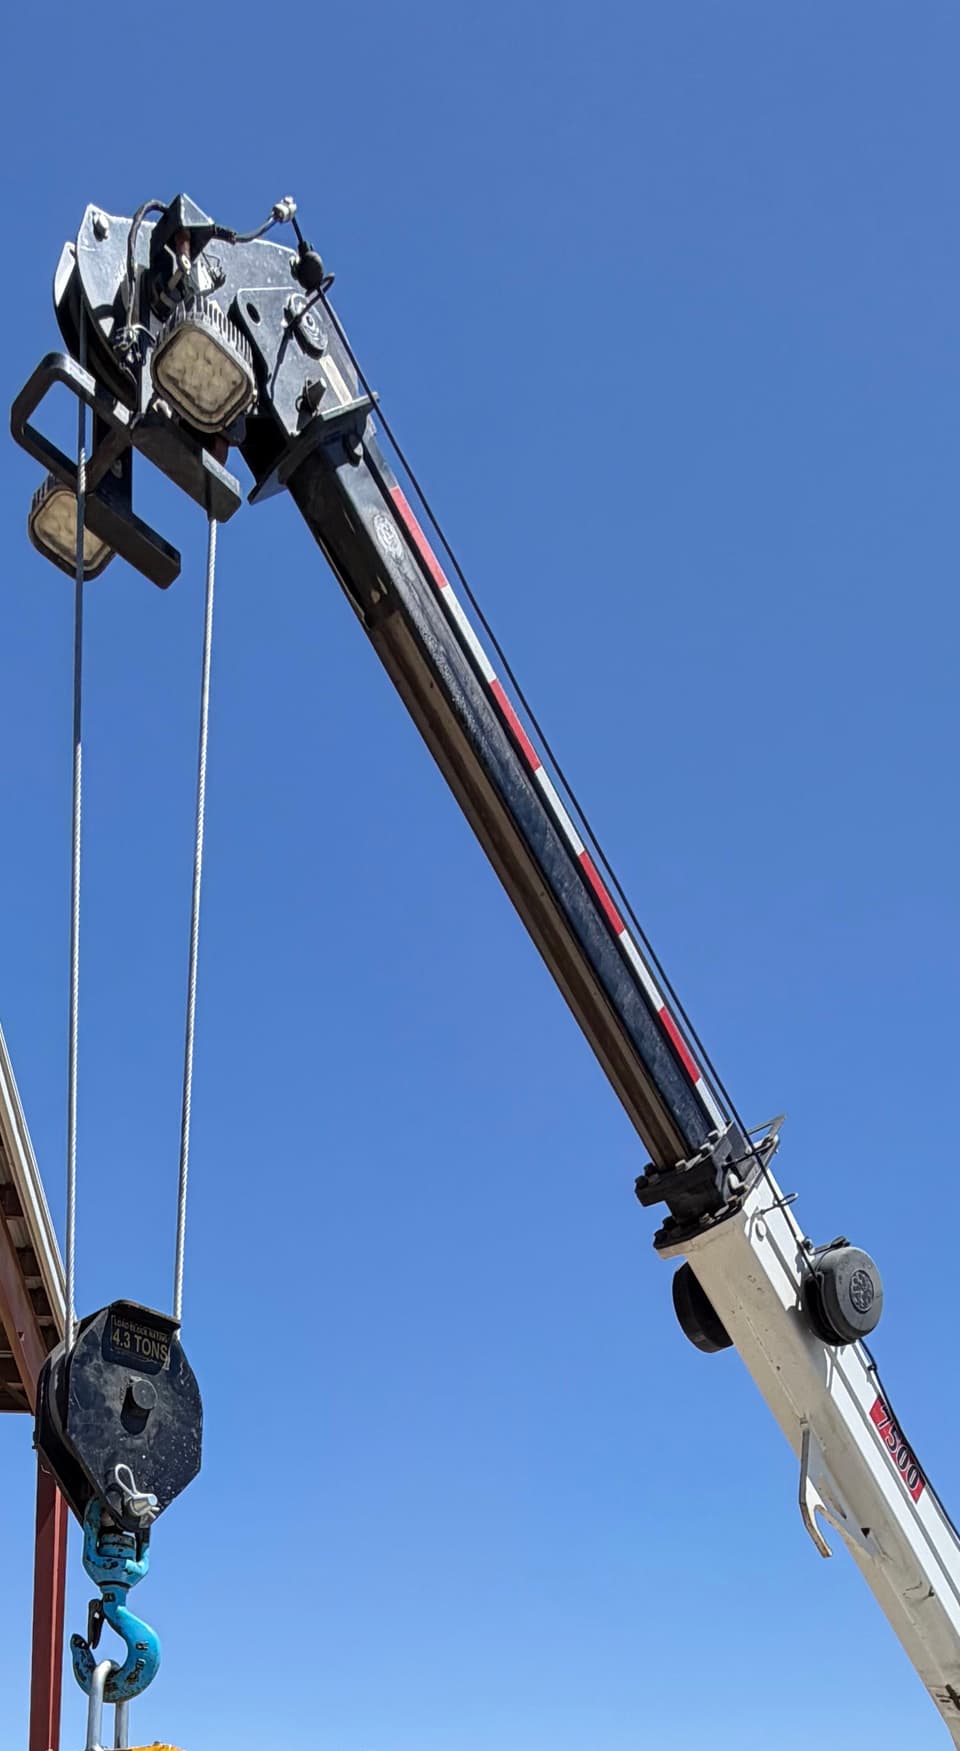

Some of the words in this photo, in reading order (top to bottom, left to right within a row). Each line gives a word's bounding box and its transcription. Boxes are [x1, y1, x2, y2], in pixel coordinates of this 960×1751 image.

[113, 1328, 131, 1349] 4.3
[134, 1334, 168, 1362] TONS
[876, 1404, 921, 1490] 7500
